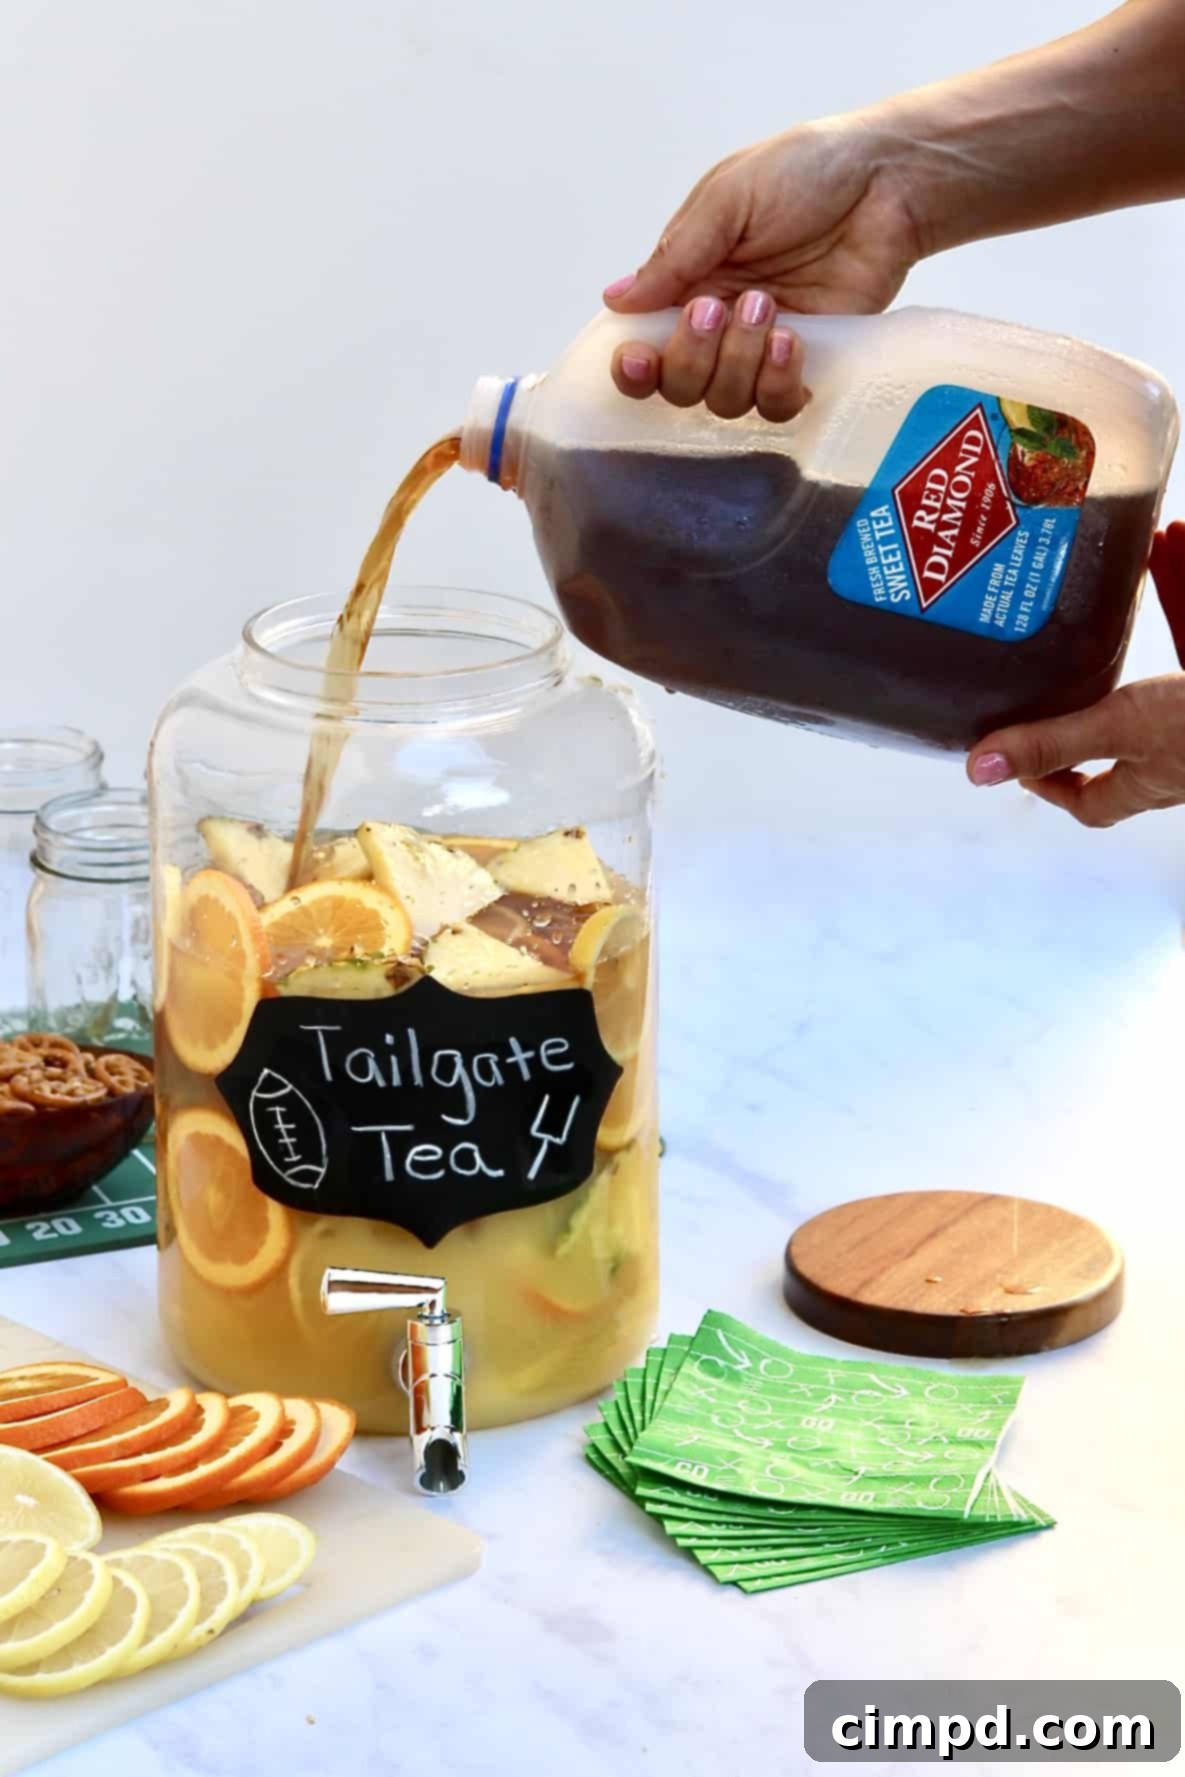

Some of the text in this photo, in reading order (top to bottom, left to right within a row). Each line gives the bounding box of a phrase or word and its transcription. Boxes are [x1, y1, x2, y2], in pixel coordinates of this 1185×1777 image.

[912, 467, 949, 533] RED
[923, 429, 984, 583] DIAMOND
[970, 482, 997, 548] Since 1906
[856, 518, 887, 602] FRESH BREWED
[870, 504, 911, 603] SWEET TEA
[994, 530, 1029, 628] ACTUAL TEA LEAVES
[979, 562, 1005, 624] MADE FROM
[1014, 613, 1029, 633] 128
[1020, 600, 1034, 613] FL
[299, 1024, 575, 1126] Tailgate
[351, 1123, 505, 1182] Tea
[25, 1217, 83, 1241] 20
[93, 1206, 152, 1229] 30
